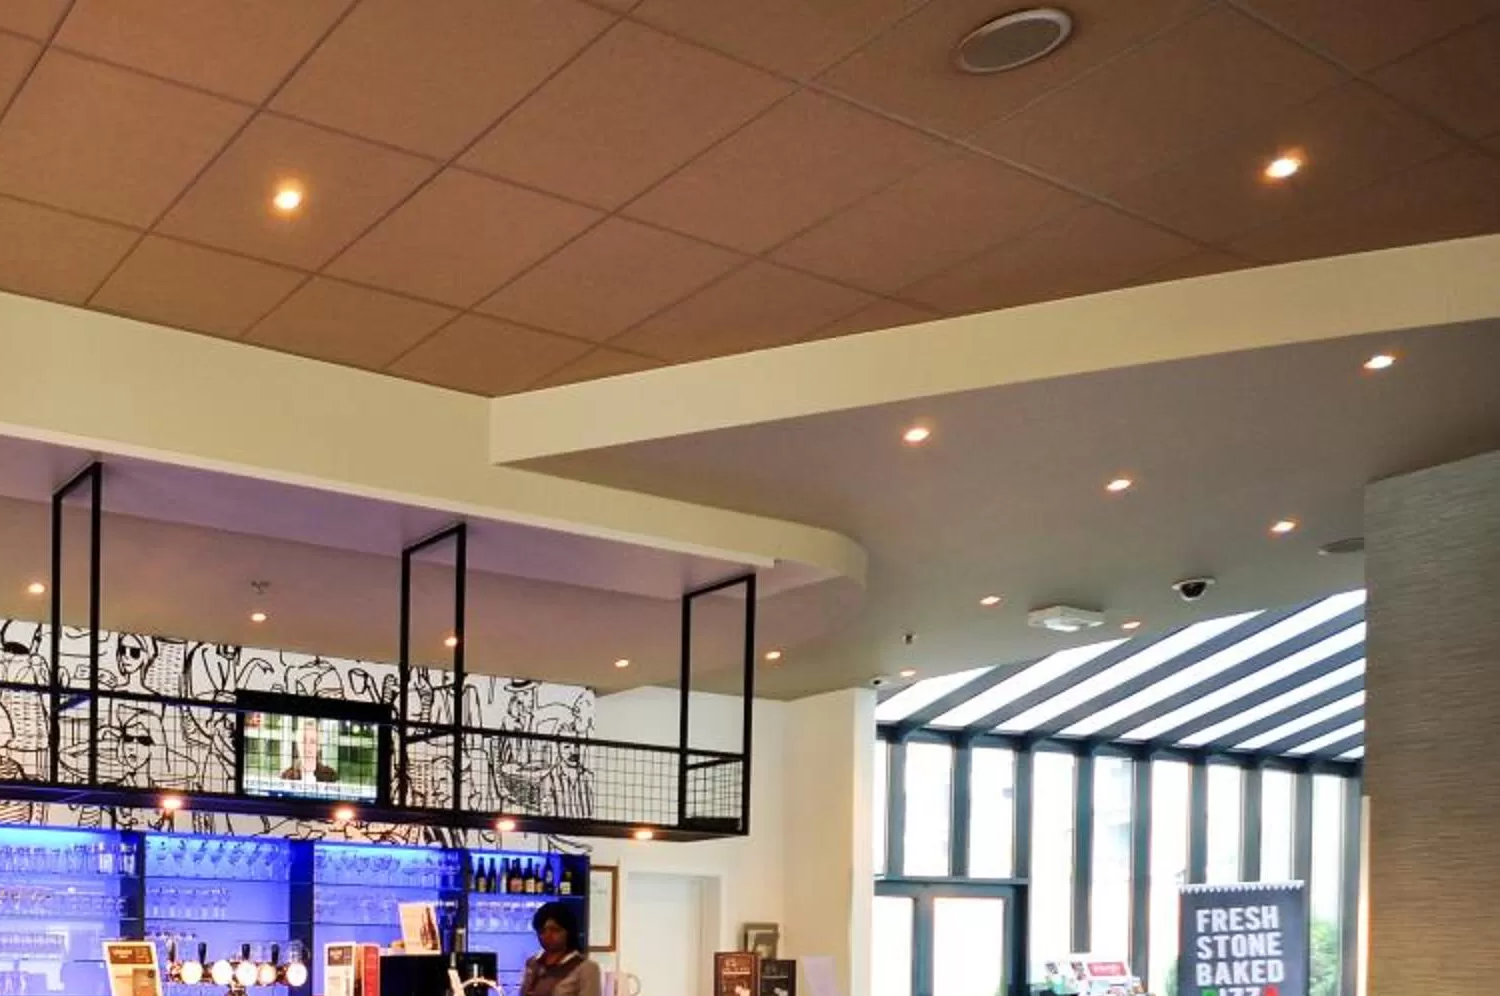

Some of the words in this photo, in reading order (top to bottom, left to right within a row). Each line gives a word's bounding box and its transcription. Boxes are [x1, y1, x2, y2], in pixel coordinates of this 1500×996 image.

[1196, 905, 1279, 933] FRESH
[1196, 932, 1283, 960] STONE
[1196, 959, 1285, 987] BAKED
